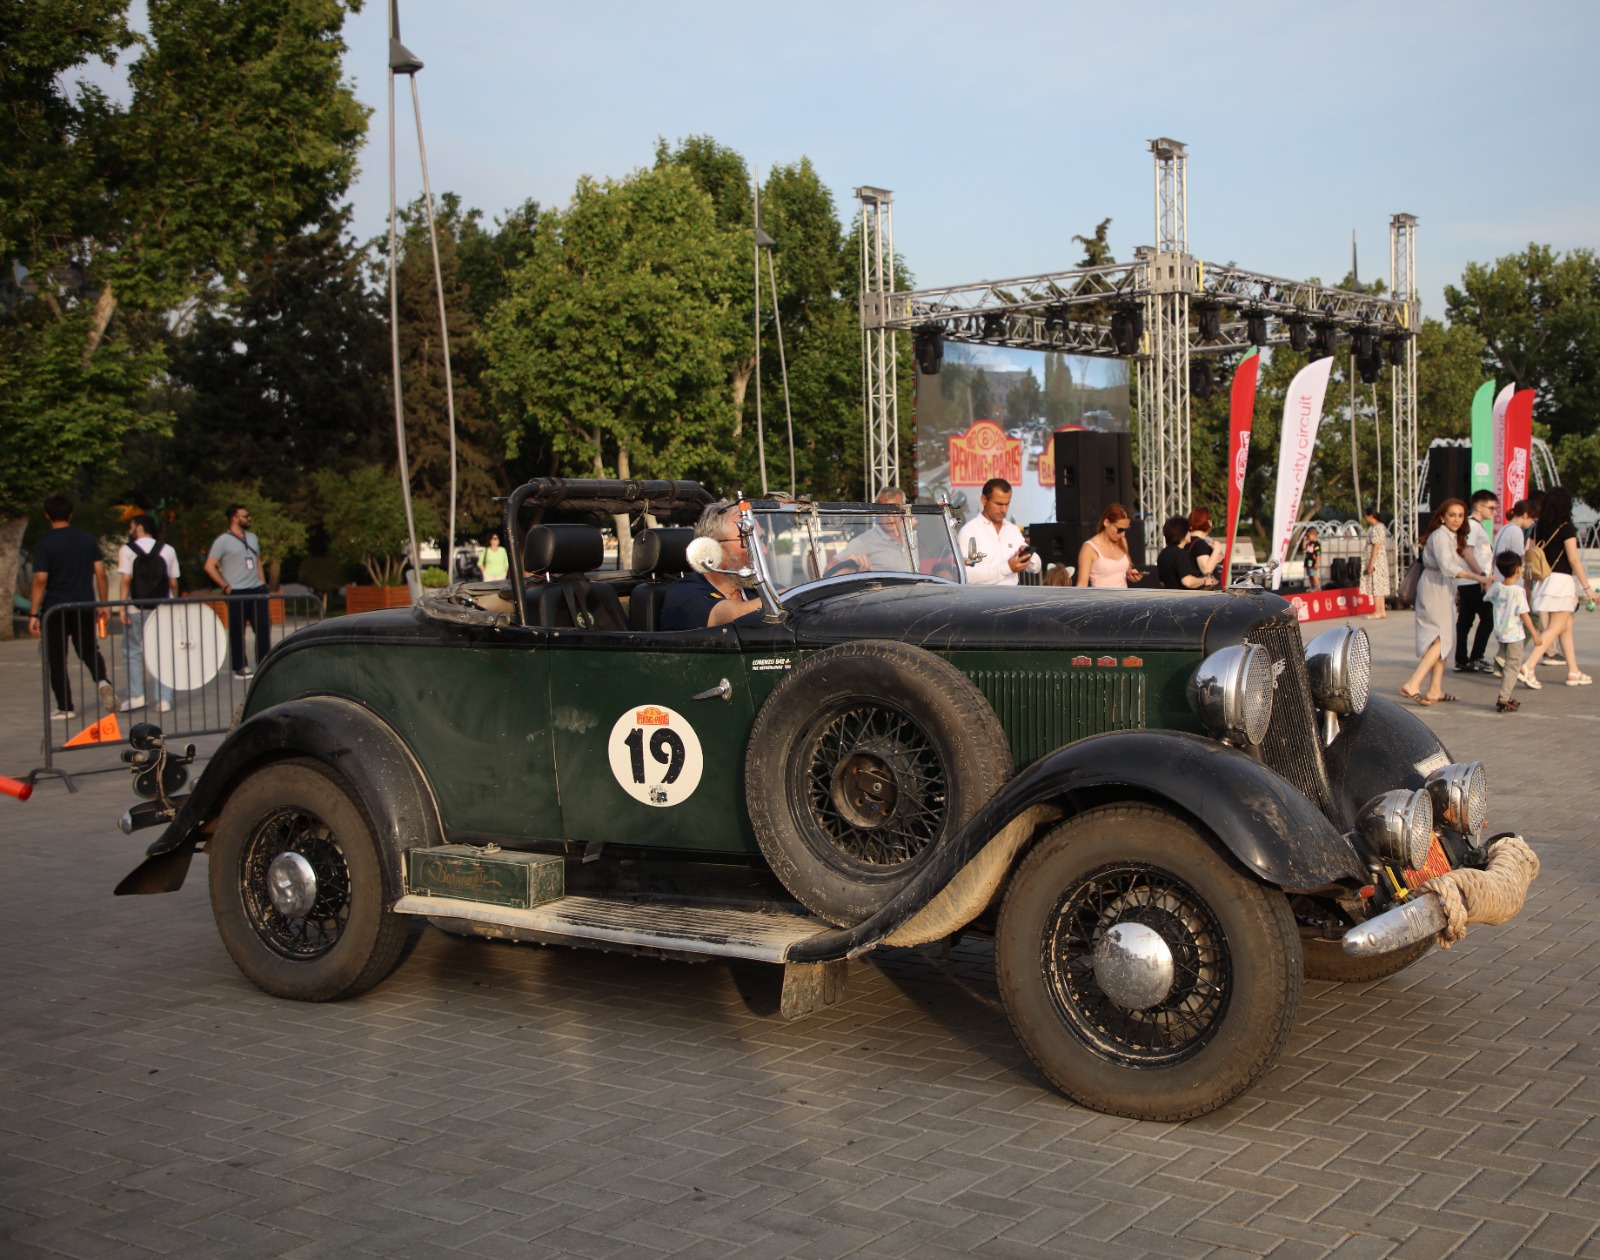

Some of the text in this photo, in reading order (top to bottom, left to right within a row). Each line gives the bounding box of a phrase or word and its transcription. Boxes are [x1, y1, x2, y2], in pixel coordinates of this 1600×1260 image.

[1296, 394, 1313, 449] circuit
[951, 441, 988, 482] PEKING
[992, 445, 1021, 482] PARIS
[624, 727, 685, 784] 19
